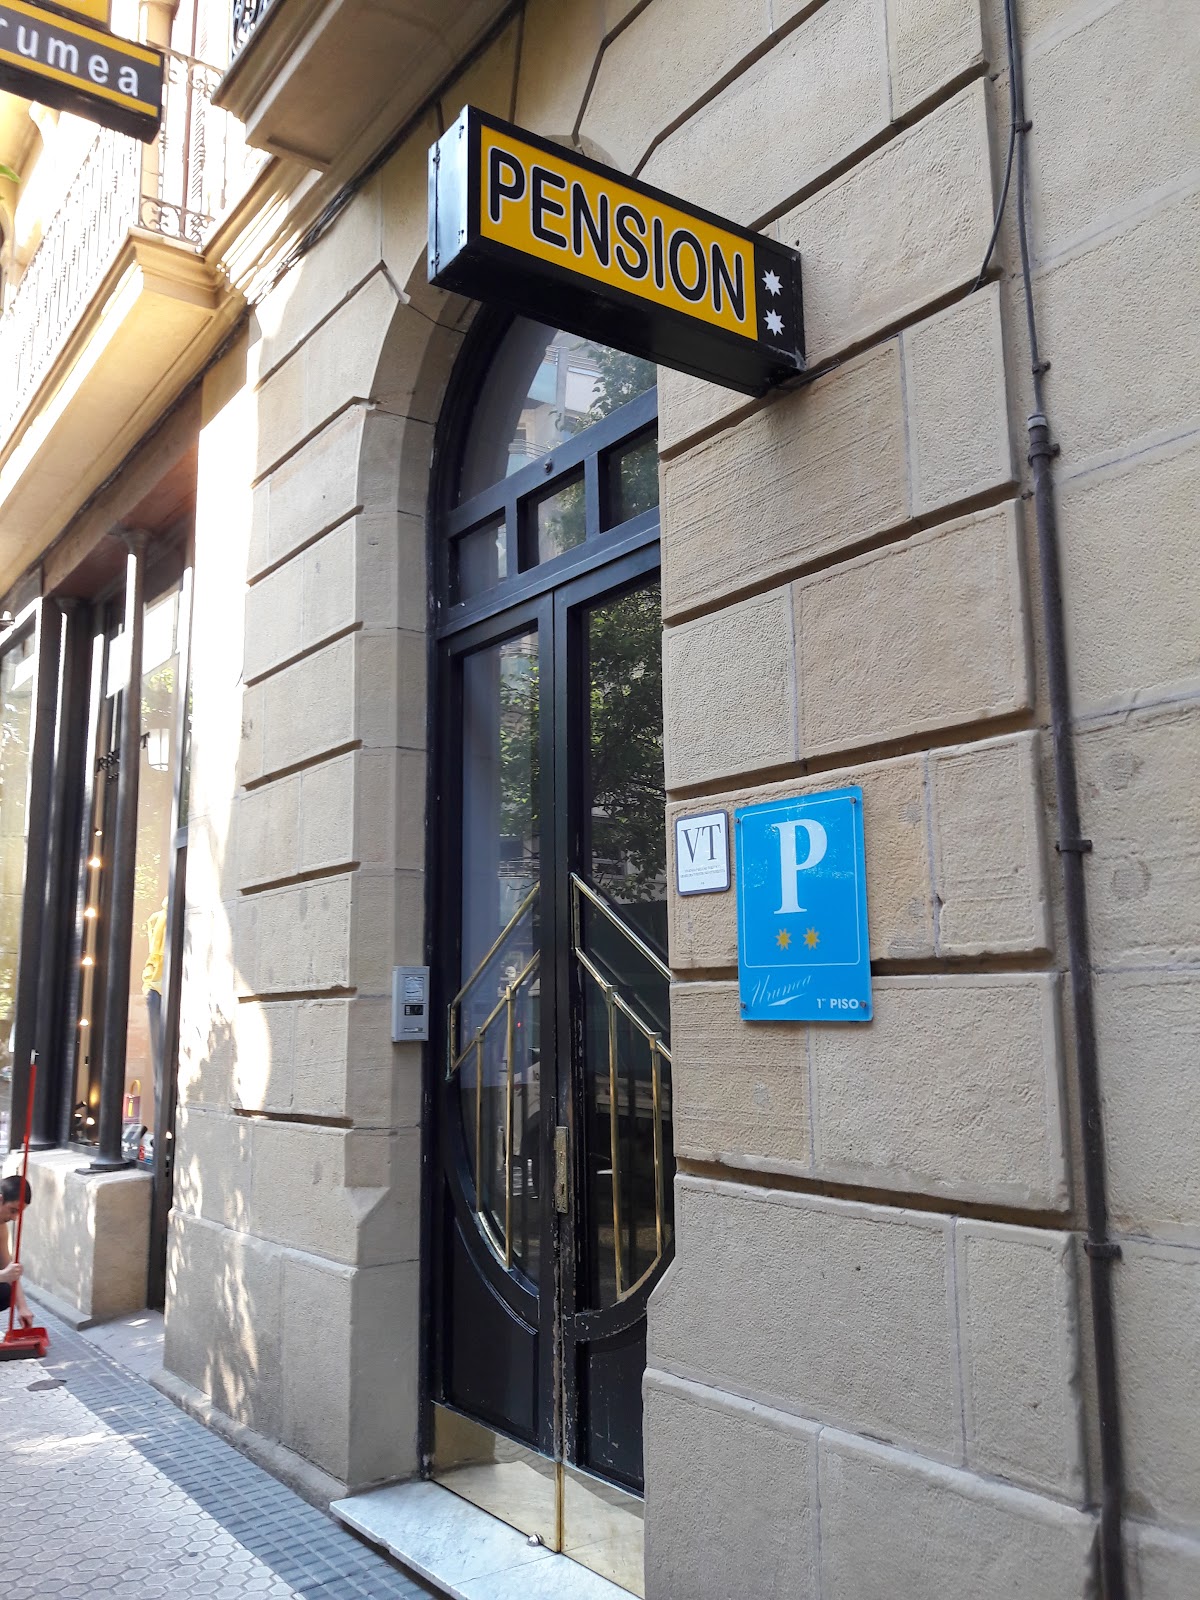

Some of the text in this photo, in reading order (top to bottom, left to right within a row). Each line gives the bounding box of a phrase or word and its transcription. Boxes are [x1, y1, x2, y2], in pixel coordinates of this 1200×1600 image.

[488, 146, 746, 323] PENSION
[681, 823, 722, 863] VT
[771, 818, 828, 915] P
[830, 998, 859, 1009] PISO
